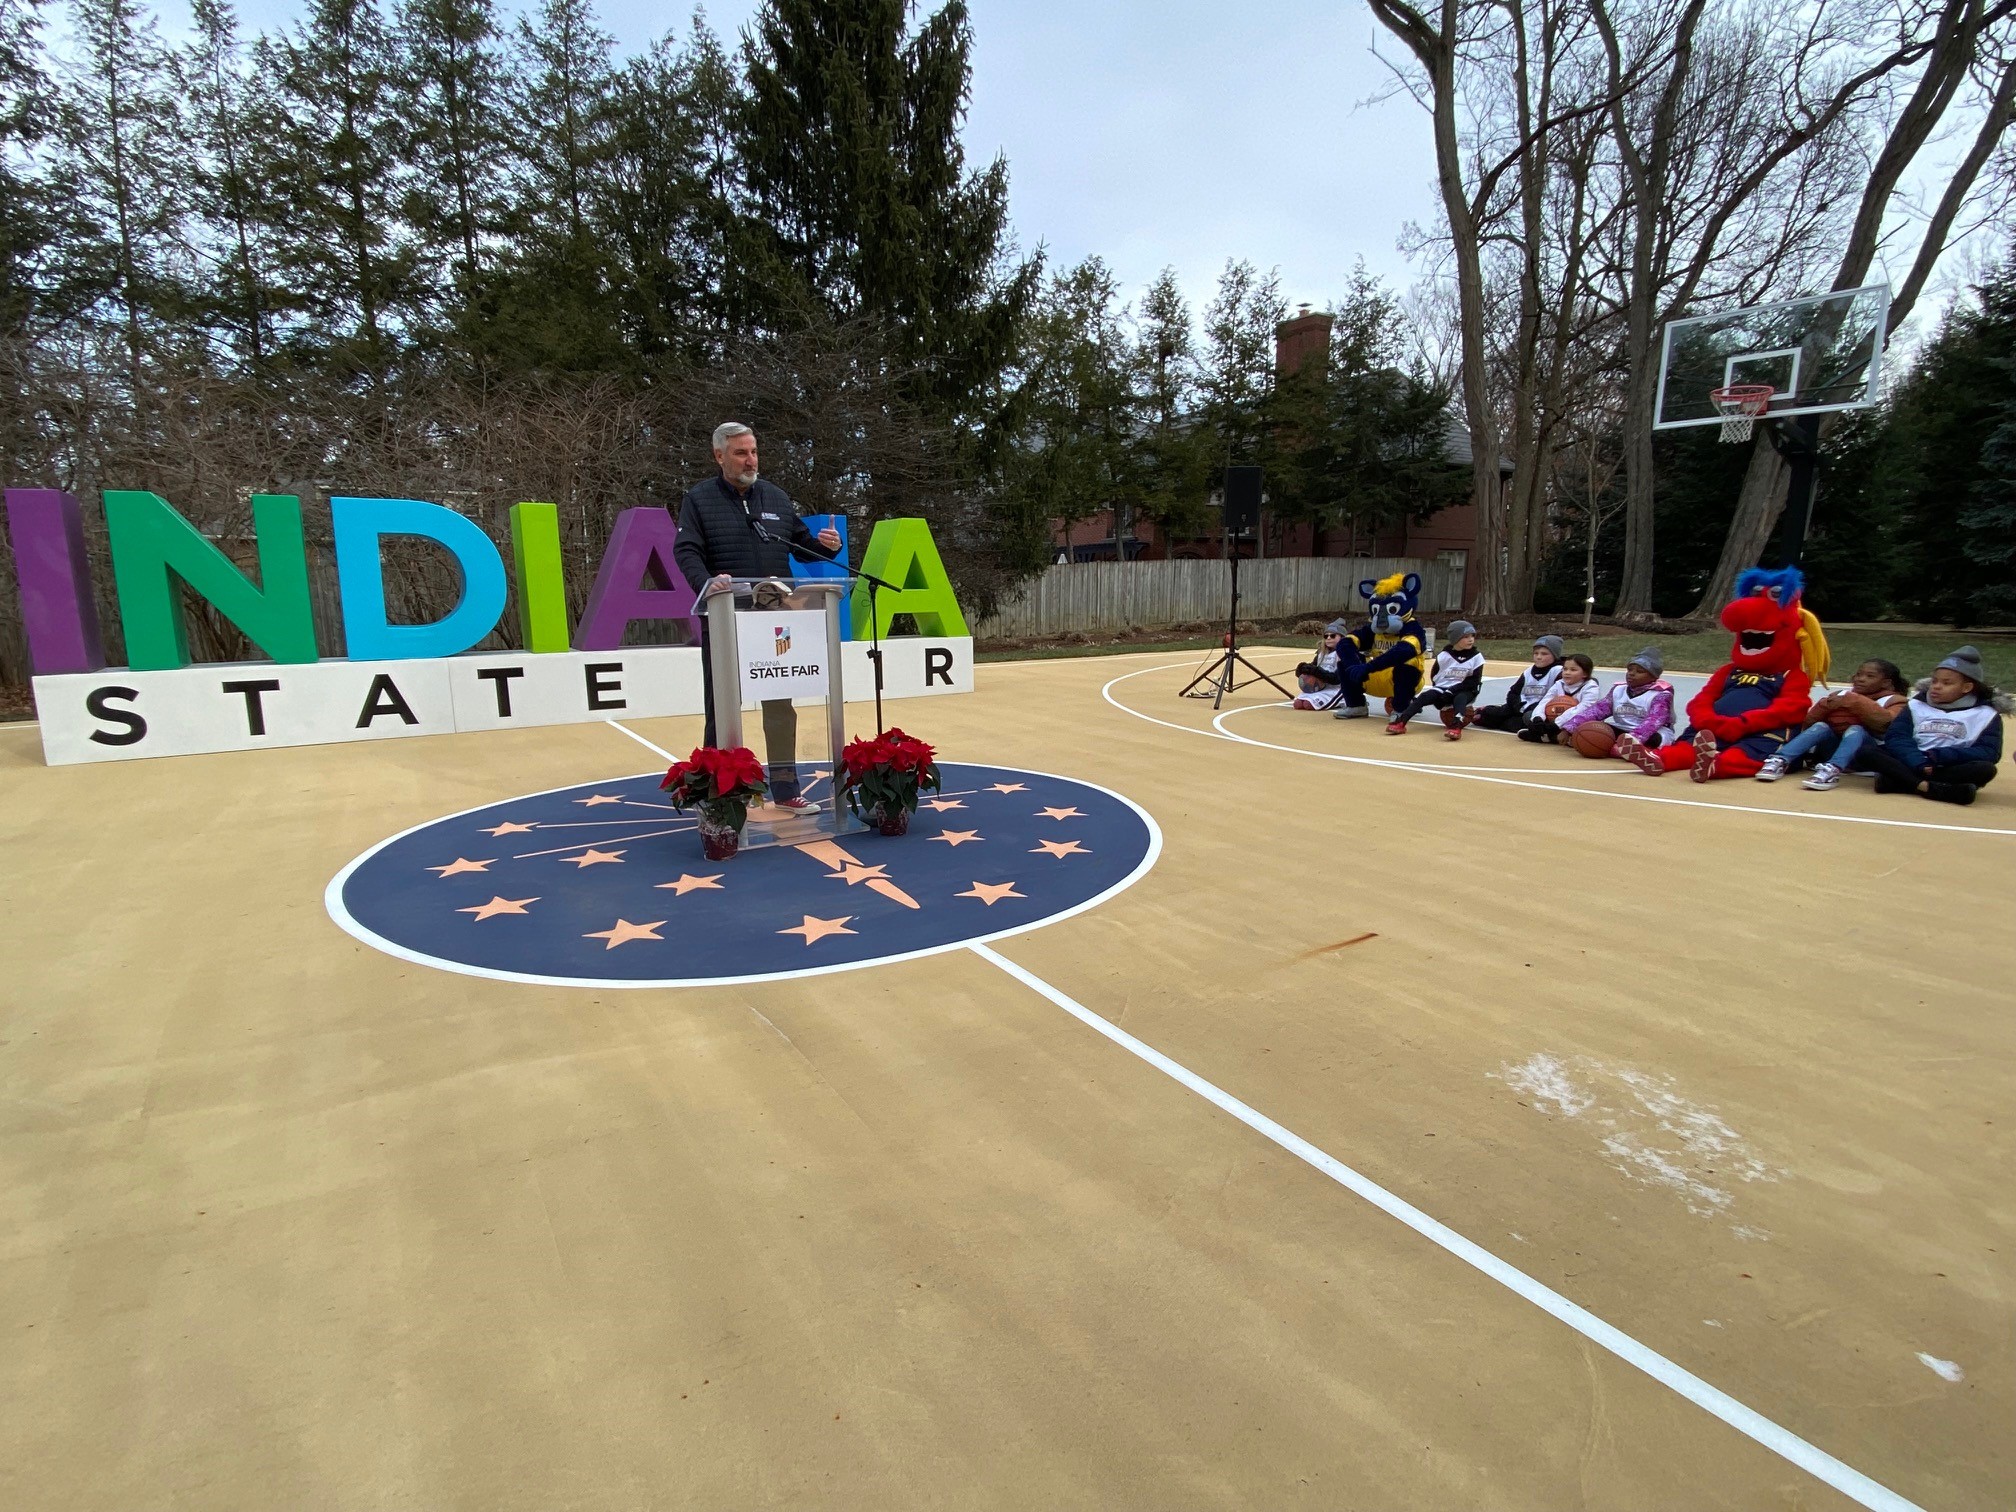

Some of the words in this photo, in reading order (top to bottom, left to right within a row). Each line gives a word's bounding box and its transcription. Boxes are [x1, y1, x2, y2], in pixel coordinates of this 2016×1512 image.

[749, 660, 780, 668] INDIANA
[750, 667, 789, 679] STATE
[791, 665, 819, 677] FAIR
[86, 662, 627, 746] STATE
